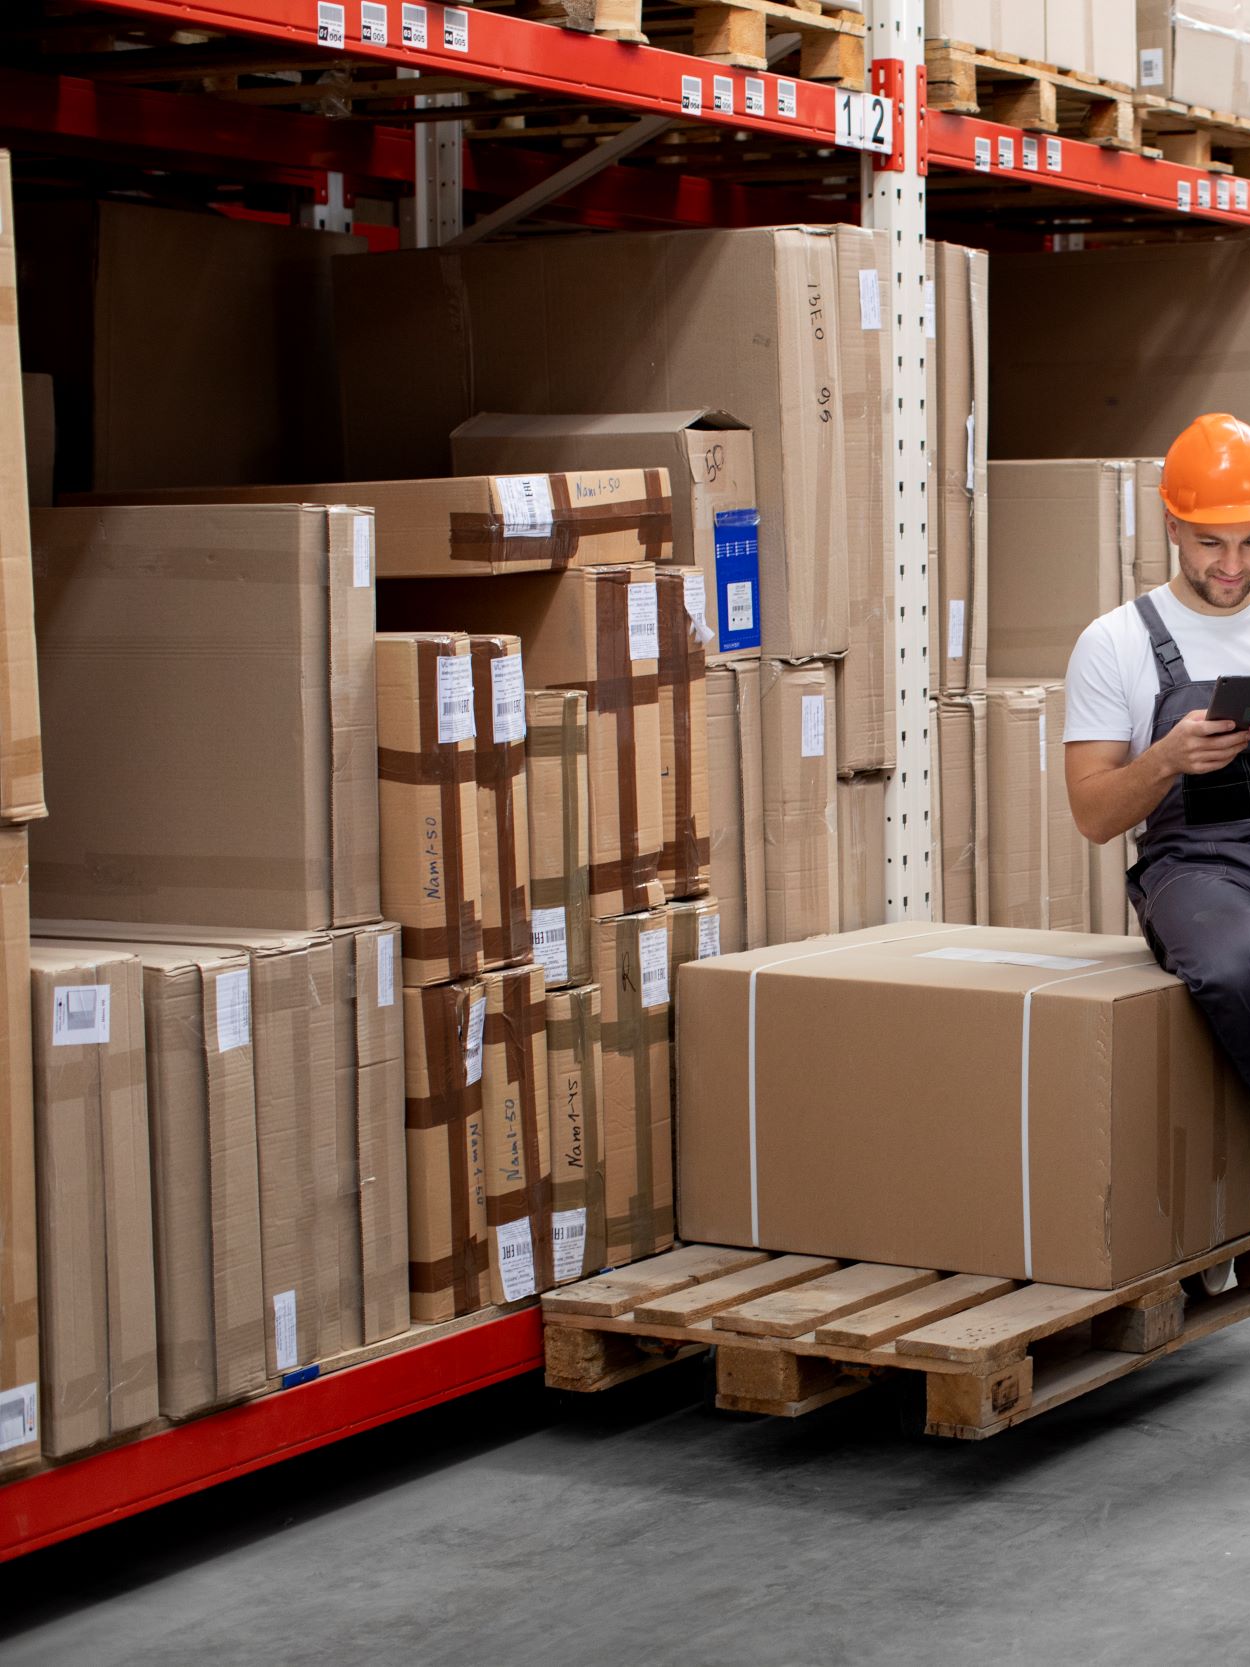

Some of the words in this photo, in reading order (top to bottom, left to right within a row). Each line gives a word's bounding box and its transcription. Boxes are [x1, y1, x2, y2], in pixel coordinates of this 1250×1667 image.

[329, 33, 342, 43] 004
[843, 95, 851, 136] 1
[871, 98, 884, 145] 2
